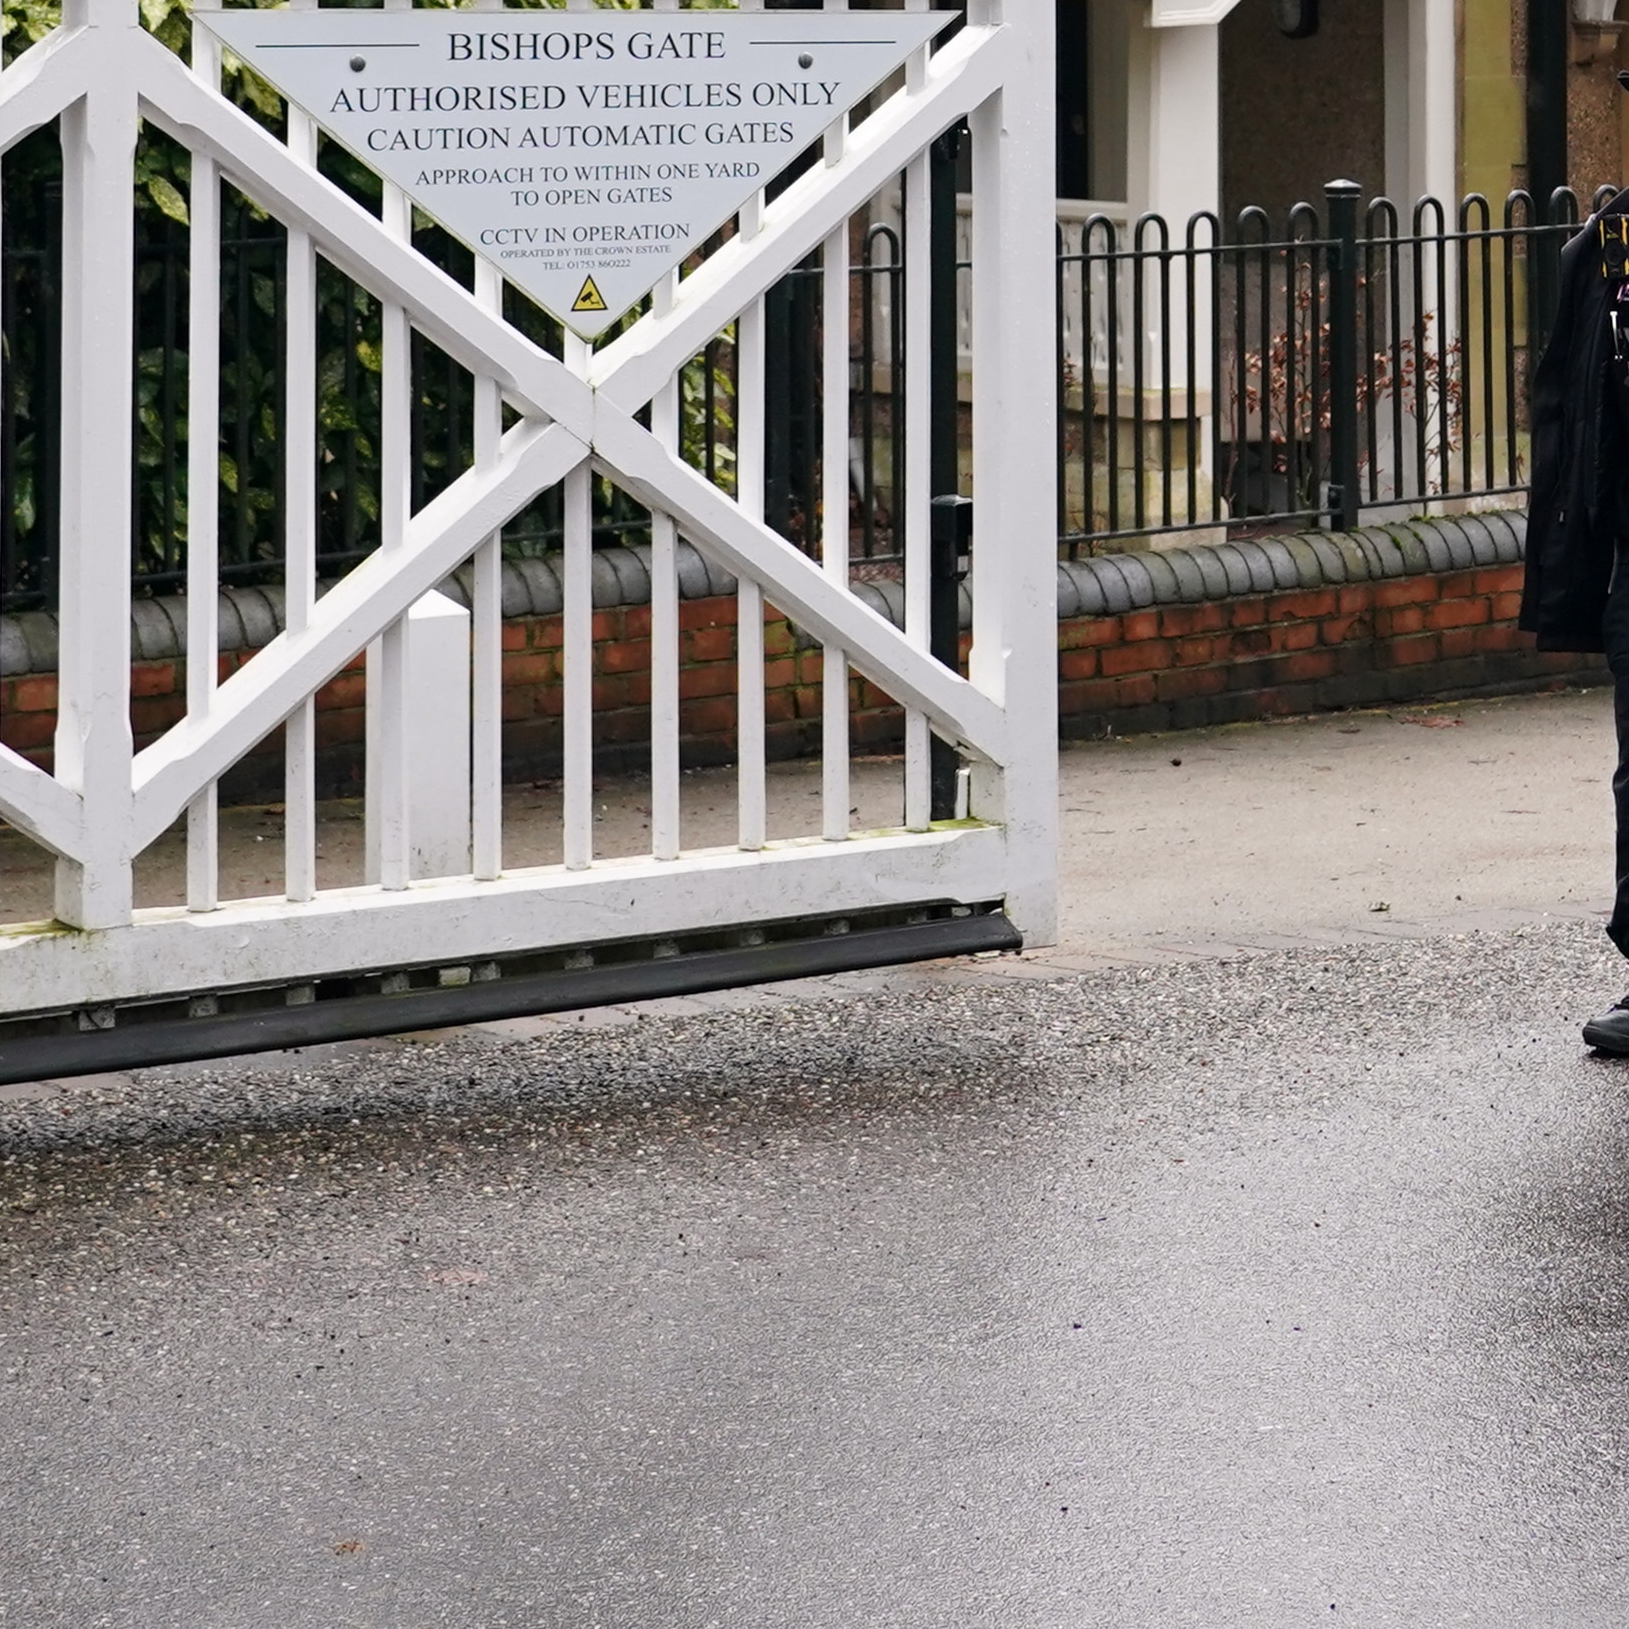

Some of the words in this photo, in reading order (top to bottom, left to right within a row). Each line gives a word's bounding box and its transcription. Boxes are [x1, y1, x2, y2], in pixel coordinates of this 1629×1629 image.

[448, 32, 615, 61] BISHOPS
[627, 31, 727, 59] GATE
[330, 84, 566, 113] AUTHORISED
[575, 82, 742, 109] VEHICLES
[752, 81, 841, 107] ONLY
[367, 126, 511, 152] CAUTION
[517, 123, 697, 149] AUTOMATIC
[704, 121, 794, 145] GATES
[415, 167, 534, 186] APPROACH
[539, 166, 569, 183] TO
[573, 164, 651, 182] WITHIN
[656, 163, 700, 180] ONE
[704, 161, 760, 179] YARD
[510, 190, 540, 207] TO
[544, 188, 601, 206] OPEN
[606, 186, 673, 204] GATES
[479, 227, 539, 246] CCTV
[545, 227, 566, 244] IN
[572, 223, 690, 243] OPERATION
[500, 247, 555, 259] OPERATED
[557, 247, 571, 257] BY
[574, 247, 594, 257] THE
[594, 246, 634, 256] CROWN
[635, 244, 671, 255] ESTATE
[543, 261, 565, 271] TEL:
[567, 260, 596, 270] 01753
[598, 258, 631, 269] 860222
